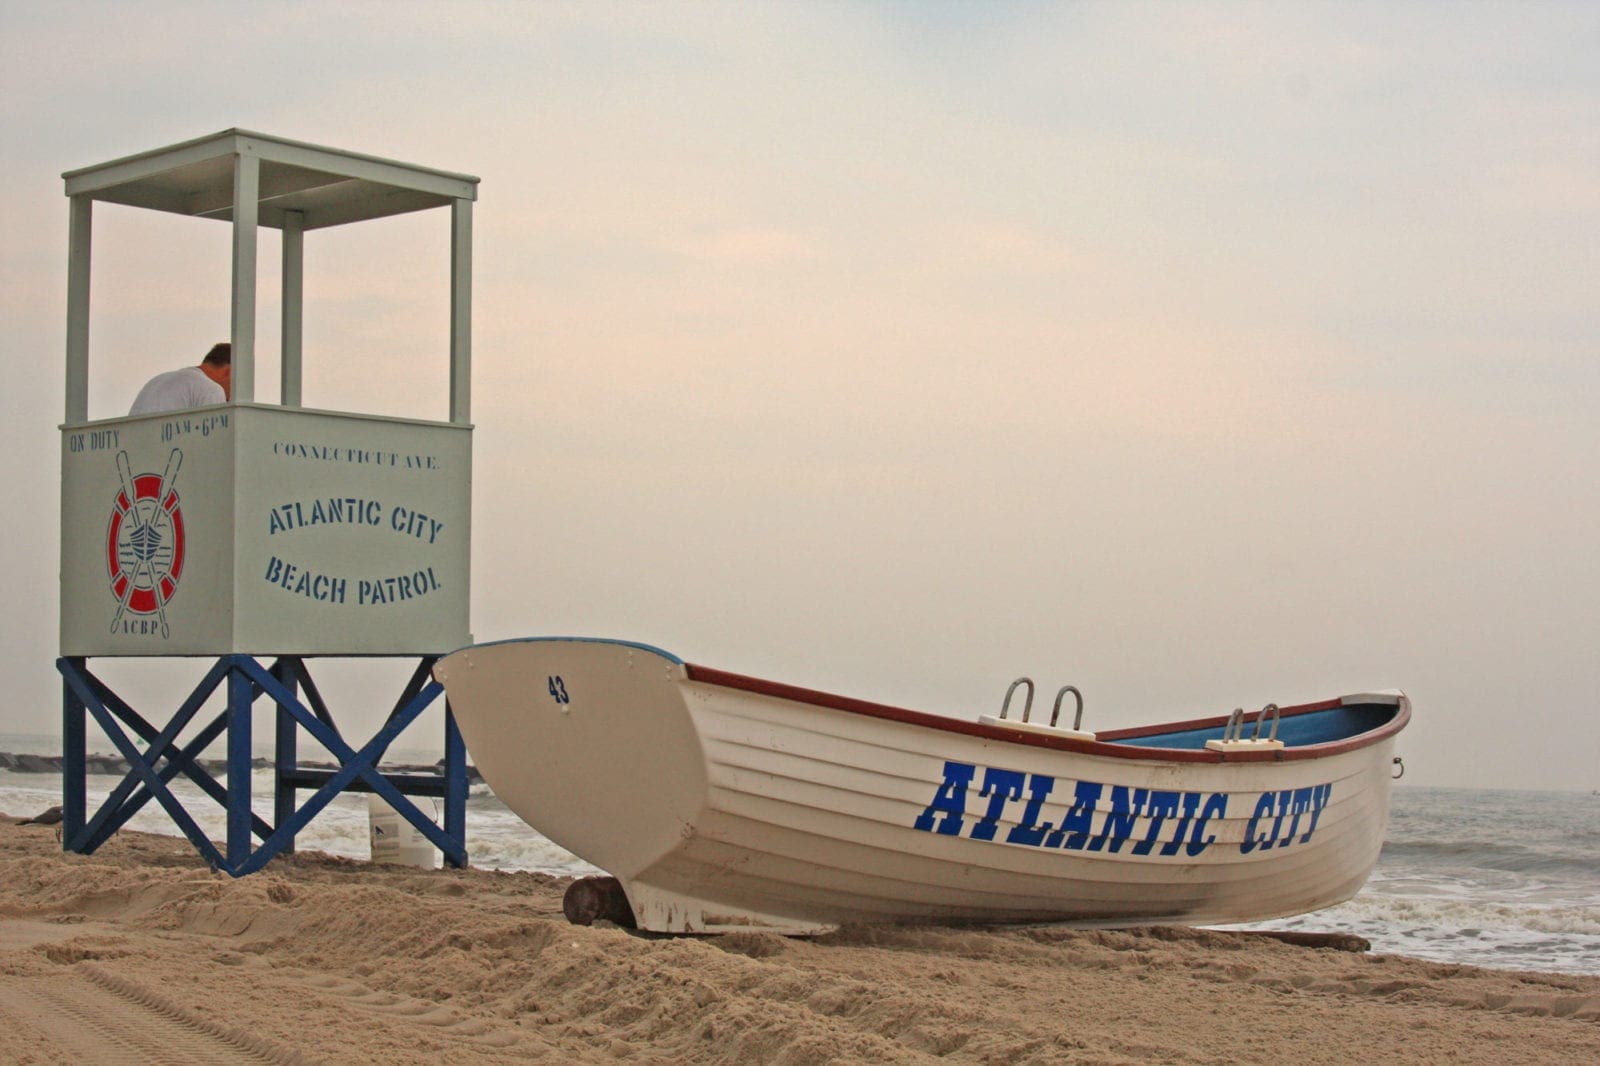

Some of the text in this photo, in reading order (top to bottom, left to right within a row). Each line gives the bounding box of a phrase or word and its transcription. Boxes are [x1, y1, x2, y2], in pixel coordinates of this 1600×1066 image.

[70, 430, 120, 452] ON DUTY
[273, 442, 398, 466] CONNECTICUT
[270, 498, 443, 544] ATLANTIC CITY
[265, 556, 441, 605] BEACH PATROL
[122, 620, 158, 635] ACBP
[548, 675, 569, 704] 43
[914, 761, 1332, 856] ATLANTIC CITY
